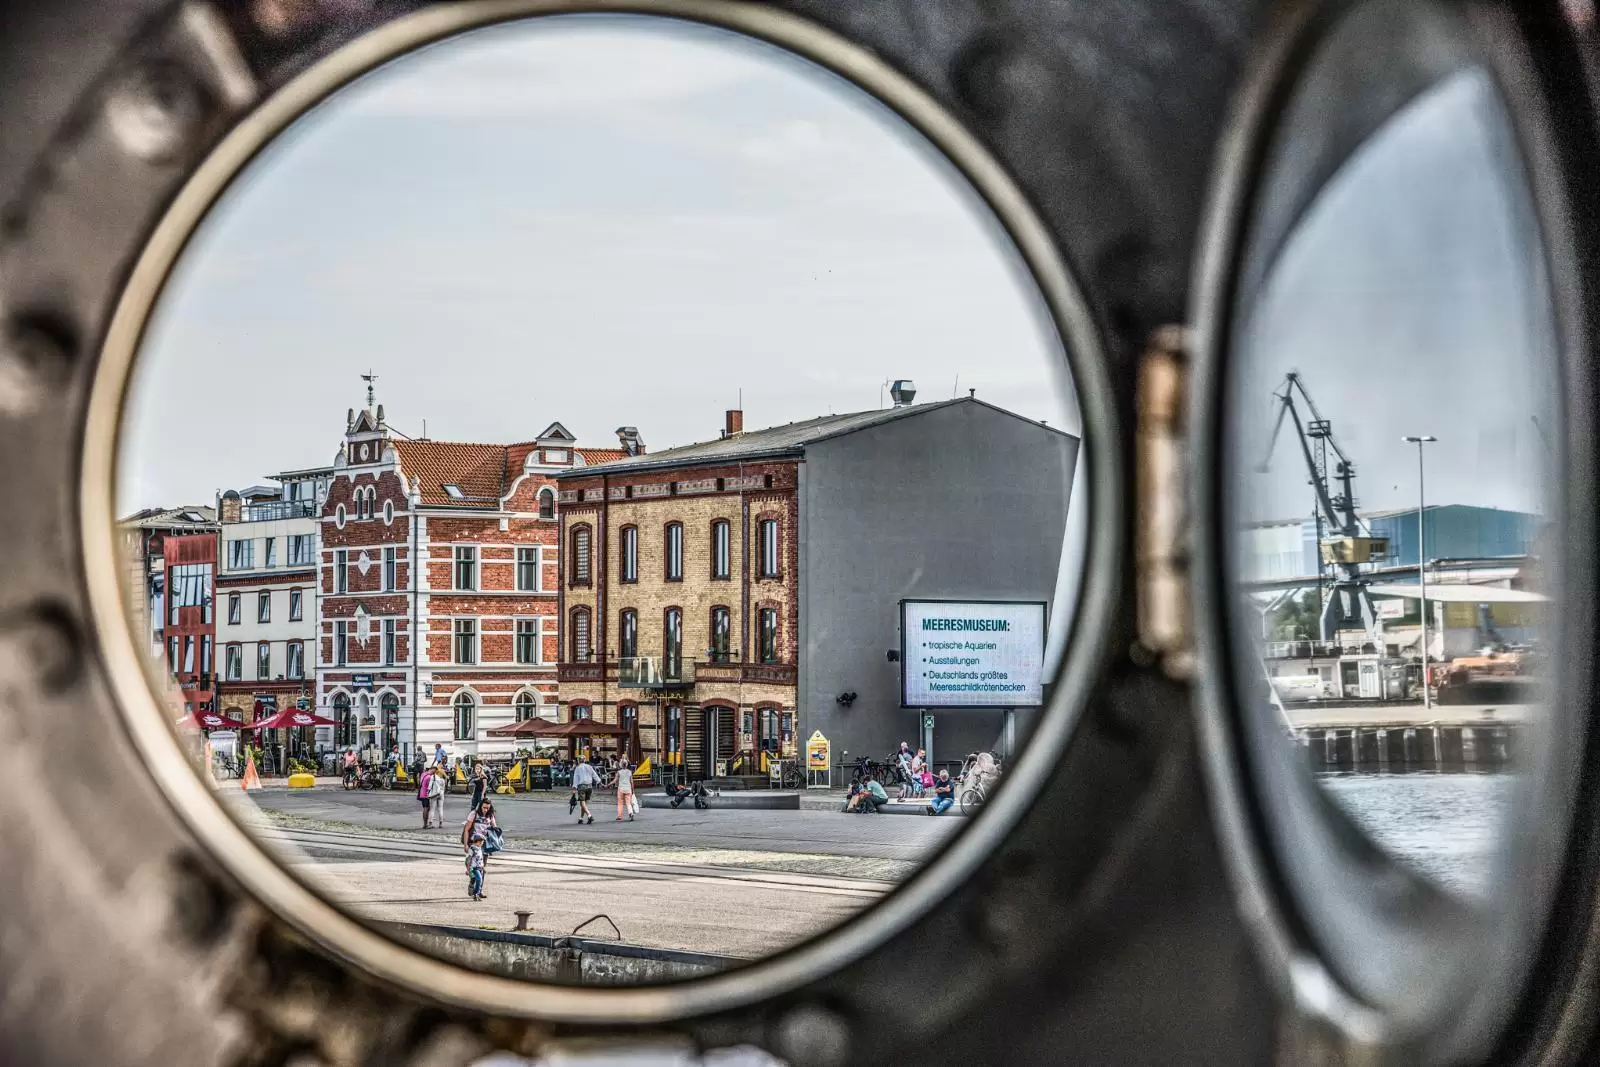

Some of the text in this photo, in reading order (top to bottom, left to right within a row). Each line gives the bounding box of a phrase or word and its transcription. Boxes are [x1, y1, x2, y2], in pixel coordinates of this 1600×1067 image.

[922, 618, 1011, 632] MEERESMUSEUM:
[928, 641, 997, 651] tropische Aquarien
[928, 656, 980, 666] Ausstellungen
[928, 670, 1008, 681] Deutschlands größtes
[929, 682, 1026, 692] Meeresschildkrötenbecken
